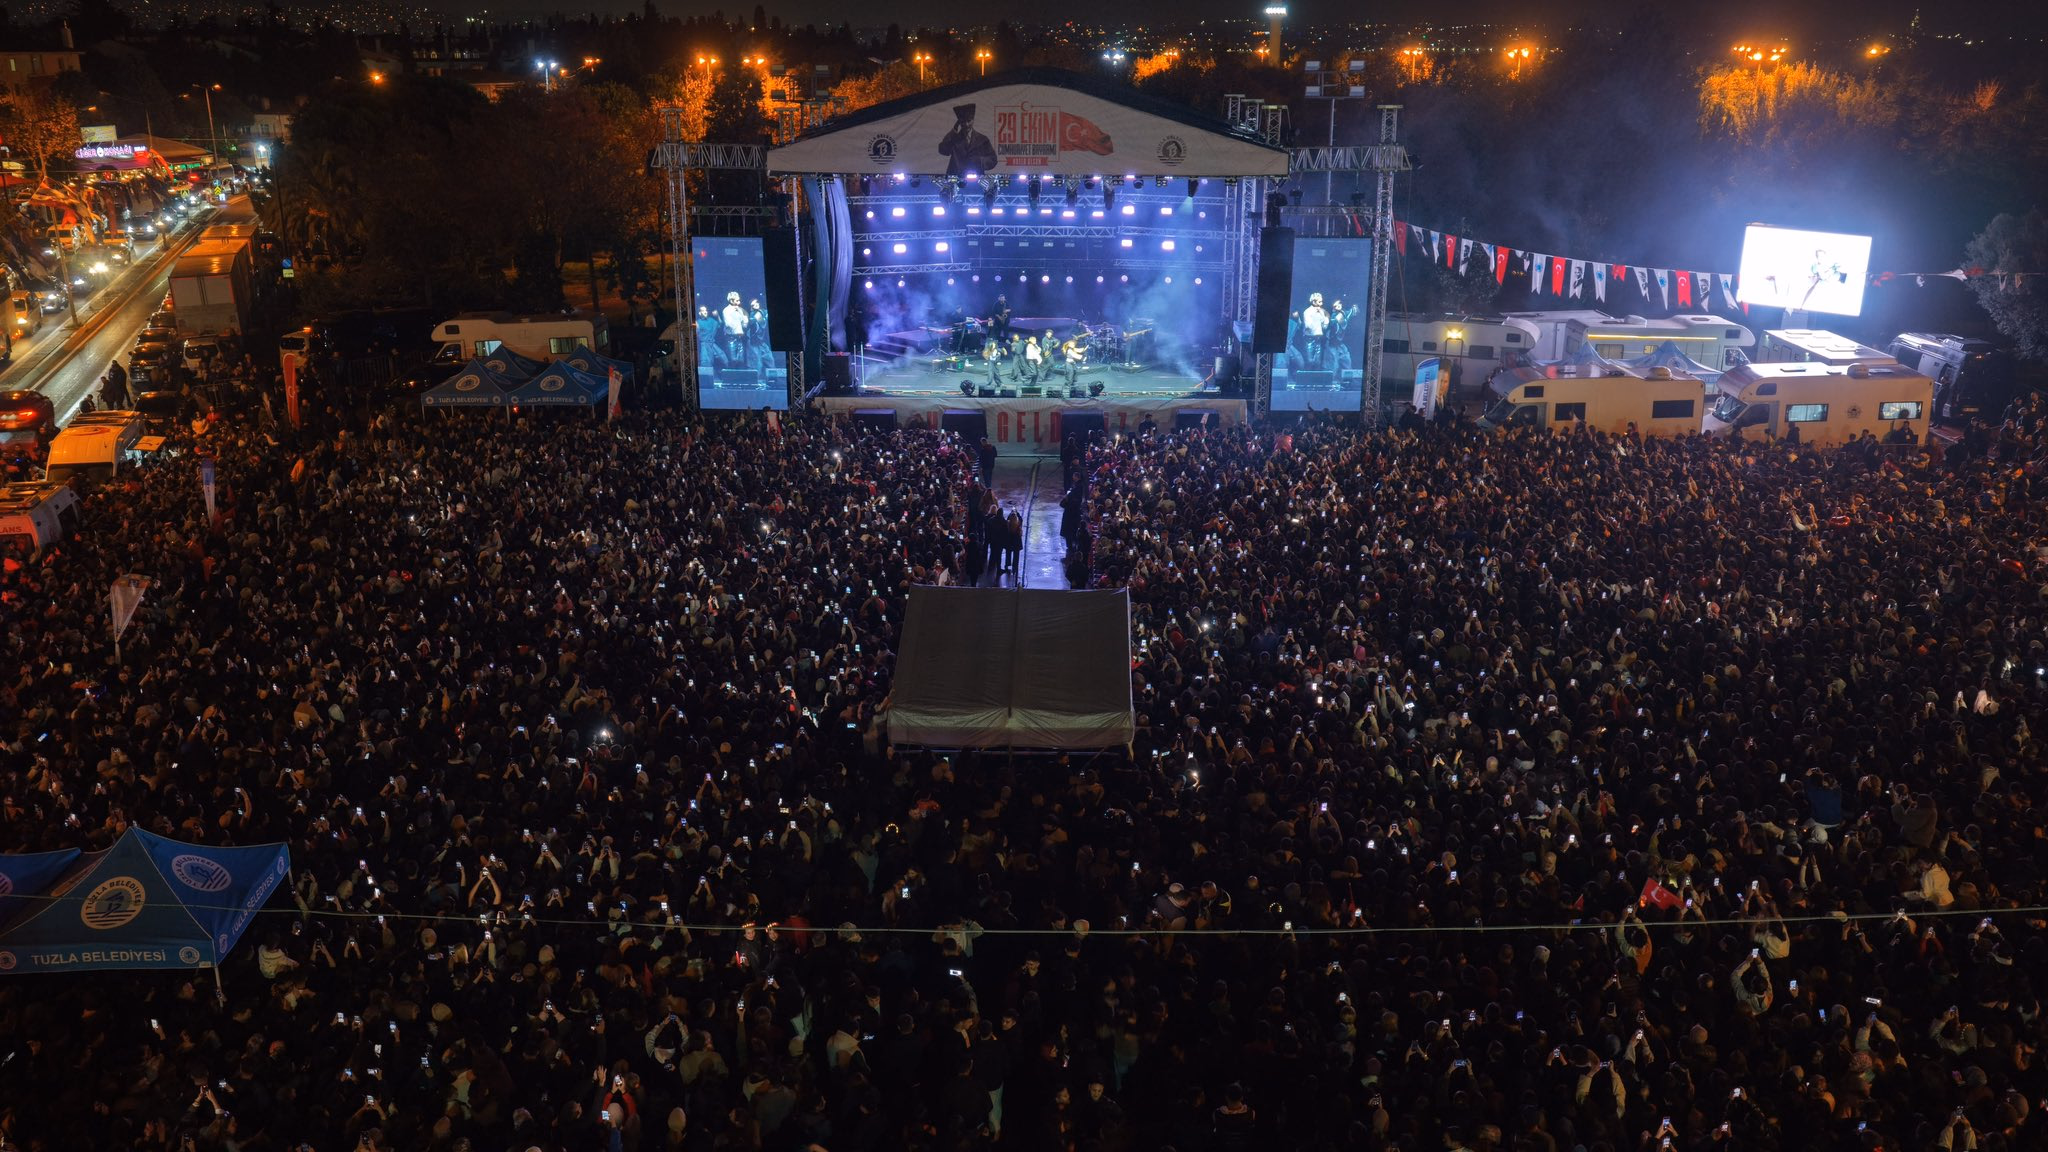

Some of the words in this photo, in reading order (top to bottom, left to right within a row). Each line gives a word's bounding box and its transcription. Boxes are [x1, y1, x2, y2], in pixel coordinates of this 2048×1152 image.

[998, 112, 1017, 144] 29
[1021, 111, 1057, 144] EKİM
[998, 144, 1031, 156] CUMHURİYET
[1032, 144, 1057, 156] BAYRAMI
[85, 886, 108, 911] TUZLA
[32, 954, 79, 967] TUZLA
[81, 948, 167, 963] BELEDİYESİ
